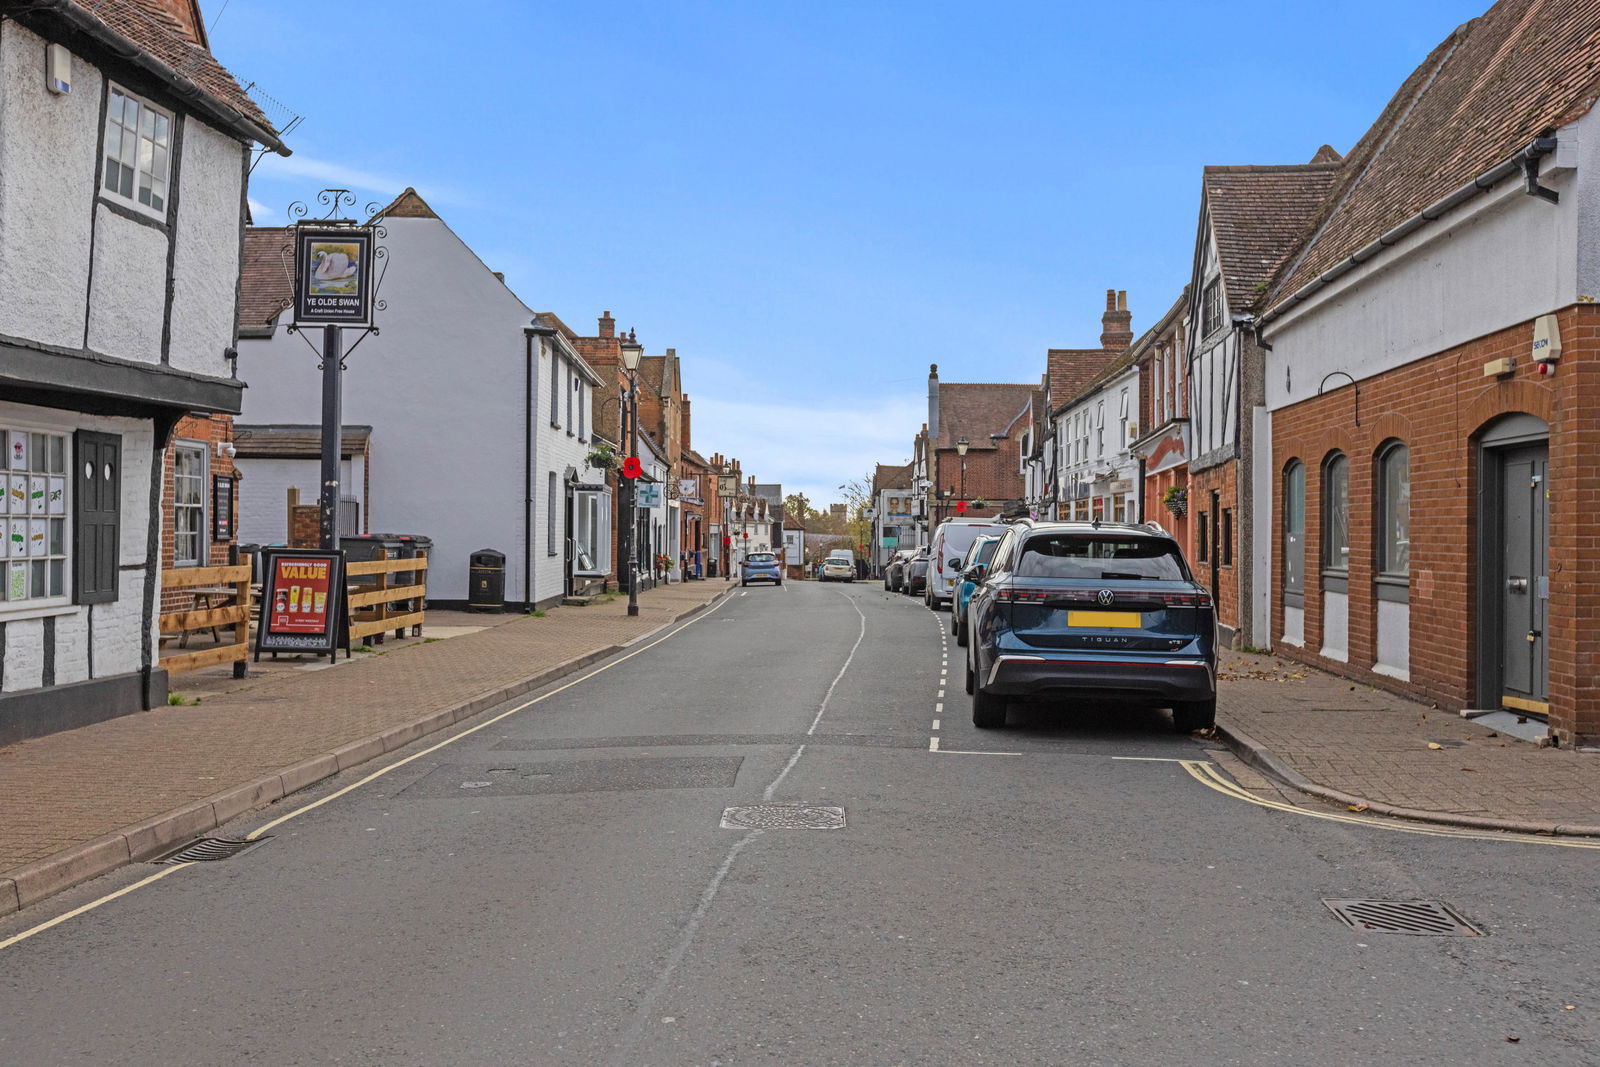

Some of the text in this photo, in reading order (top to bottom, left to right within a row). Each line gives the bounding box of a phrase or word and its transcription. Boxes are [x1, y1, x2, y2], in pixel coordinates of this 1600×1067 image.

[307, 298, 359, 306] YE OLDE SWAN
[282, 566, 326, 579] VALUE
